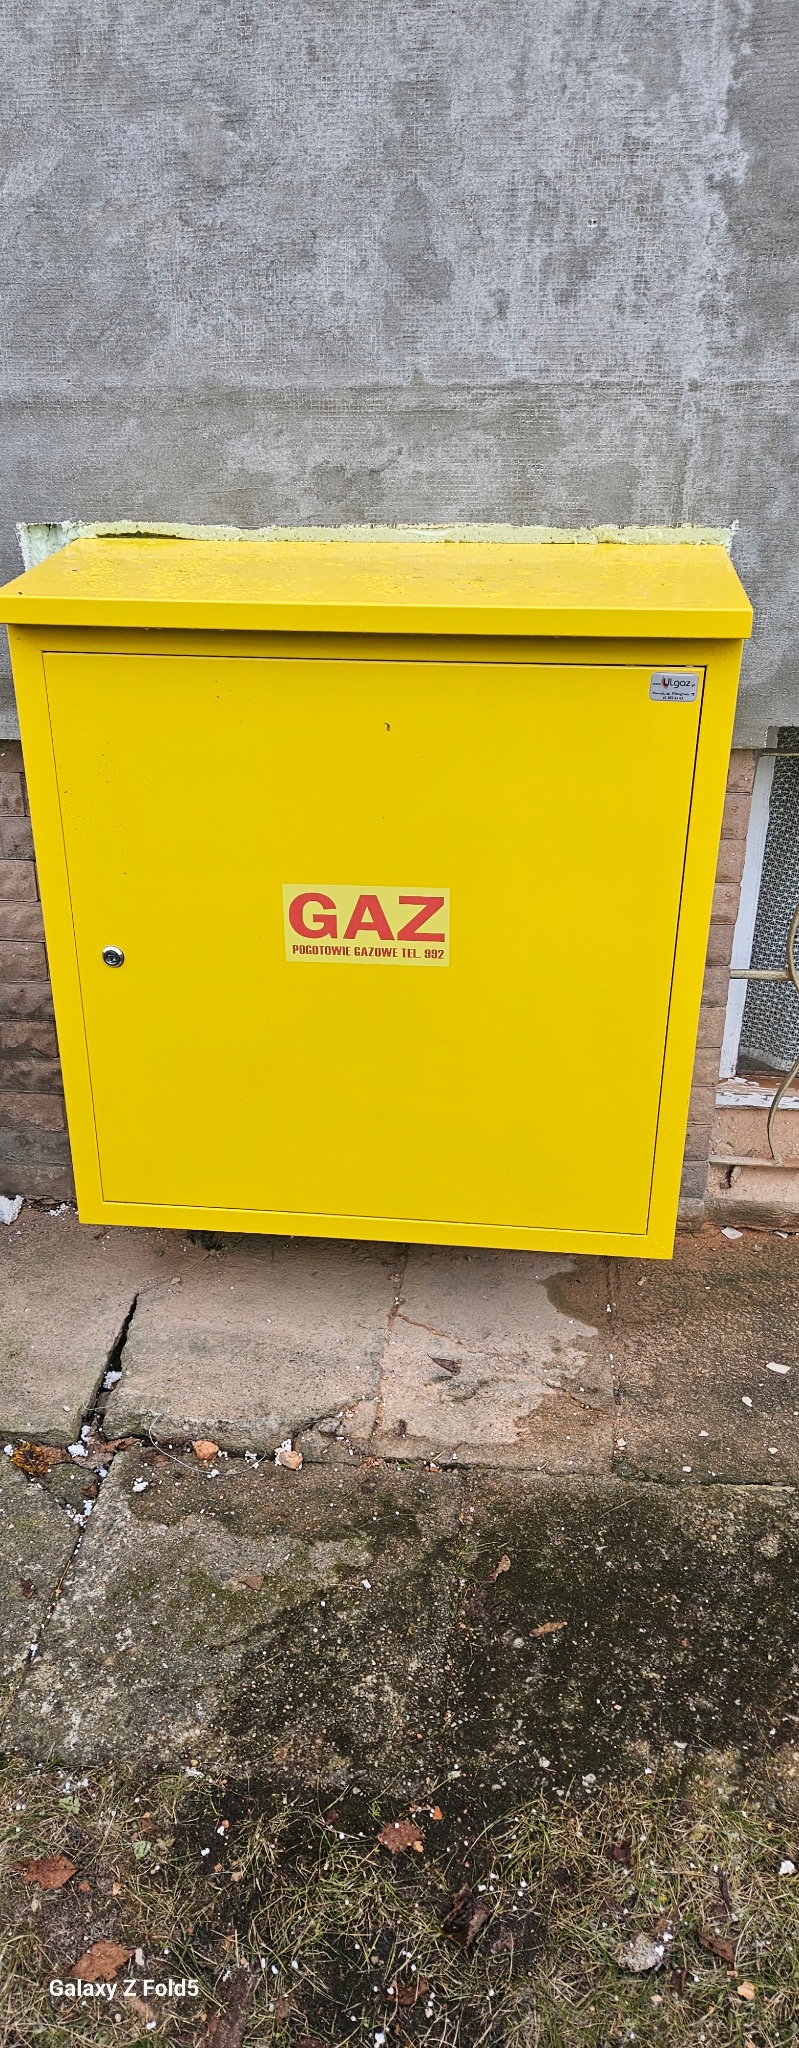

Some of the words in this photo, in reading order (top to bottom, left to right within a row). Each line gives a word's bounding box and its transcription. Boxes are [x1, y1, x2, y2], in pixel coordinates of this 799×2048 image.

[289, 892, 445, 942] GAZ
[292, 945, 351, 956] POGOTOWIE
[354, 947, 398, 957] GAZOWE
[401, 948, 421, 958] TEL.
[424, 949, 444, 959] 992
